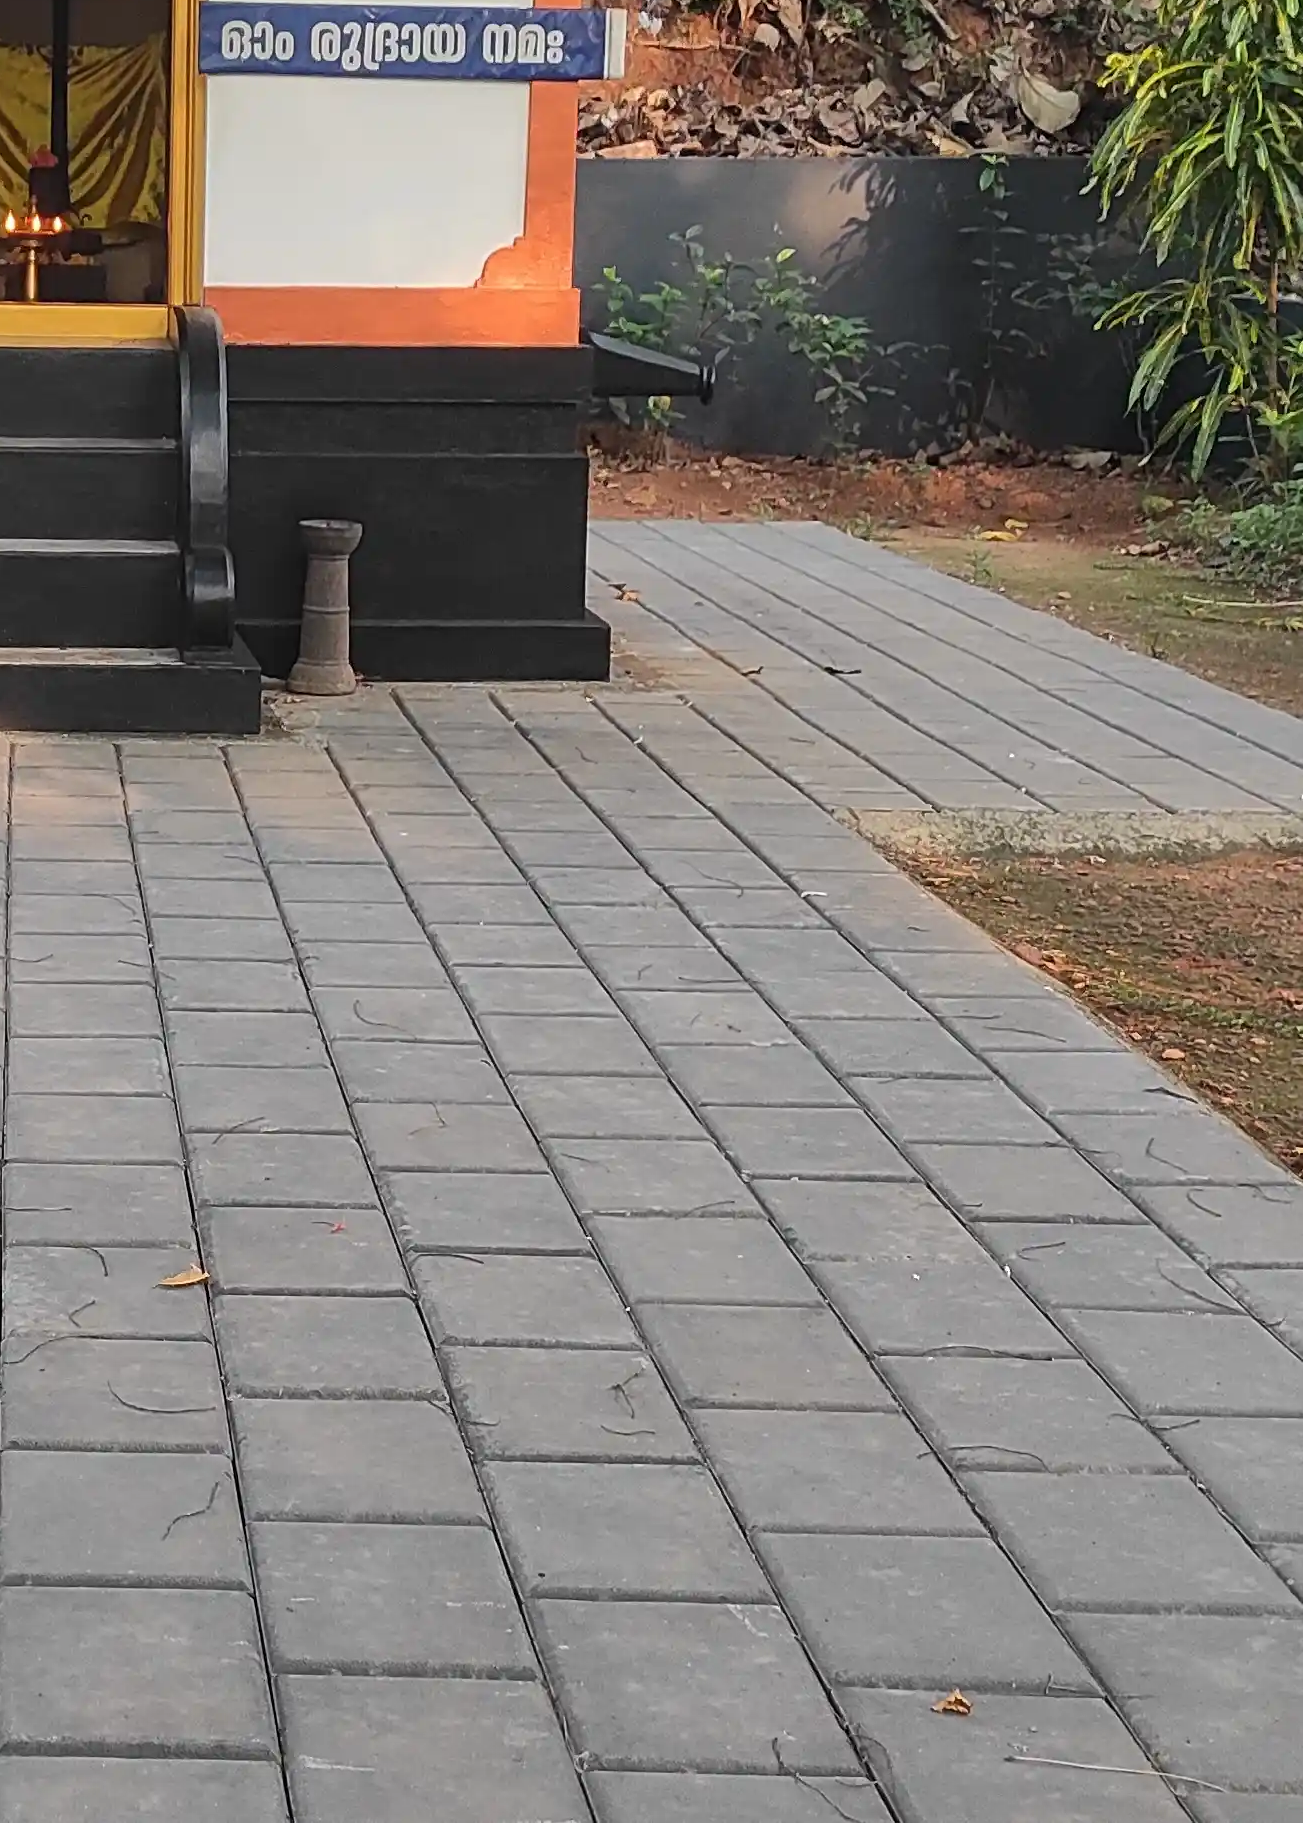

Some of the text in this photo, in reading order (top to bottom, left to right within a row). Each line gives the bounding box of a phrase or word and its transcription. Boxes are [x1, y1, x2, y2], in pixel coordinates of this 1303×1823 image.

[221, 20, 565, 71] ഓം രുദ്രായ നമഃ
